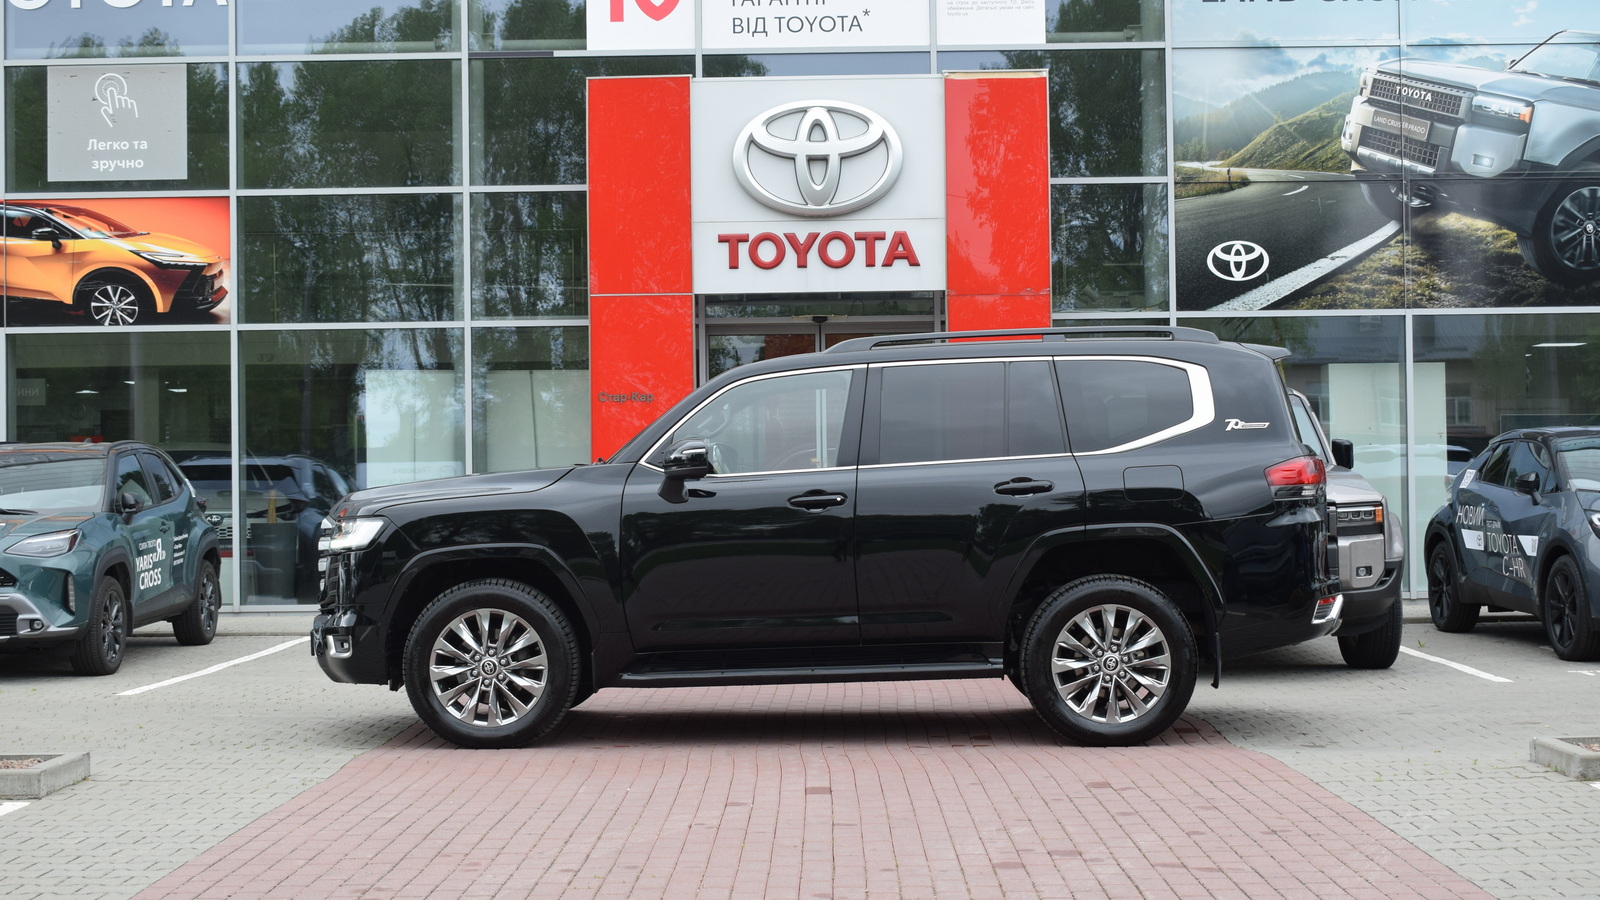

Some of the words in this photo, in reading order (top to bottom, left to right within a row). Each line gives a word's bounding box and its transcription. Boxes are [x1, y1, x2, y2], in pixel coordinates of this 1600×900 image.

[732, 17, 768, 37] ВІД
[1396, 86, 1432, 101] TOYOTA
[1373, 115, 1387, 124] LAND
[1408, 123, 1426, 134] PRADO
[87, 139, 129, 150] Легко
[132, 140, 148, 150] та
[91, 159, 144, 172] зручно
[718, 231, 921, 269] TOYOTA
[598, 391, 655, 404] Стар-Кар
[1455, 503, 1485, 526] НОВИЙ
[1486, 532, 1520, 555] TOYOTA
[135, 553, 153, 572] YARIS
[1502, 556, 1527, 578] C-HR
[139, 567, 162, 590] CROSS
